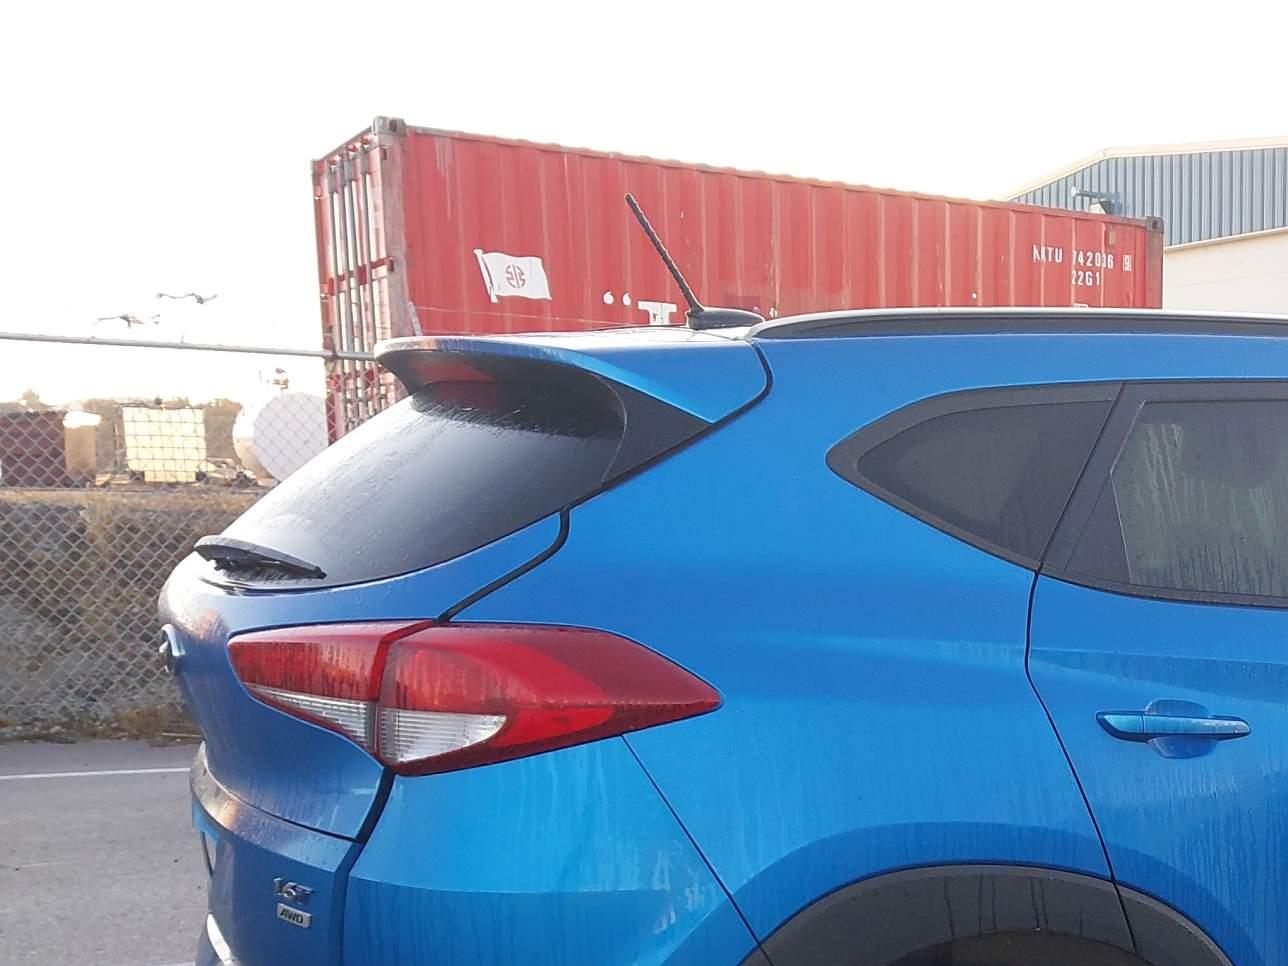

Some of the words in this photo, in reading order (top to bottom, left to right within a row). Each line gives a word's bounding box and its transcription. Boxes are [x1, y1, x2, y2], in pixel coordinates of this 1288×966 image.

[1123, 255, 1132, 271] 9
[1071, 270, 1100, 286] 22G1
[279, 908, 305, 925] AWD
